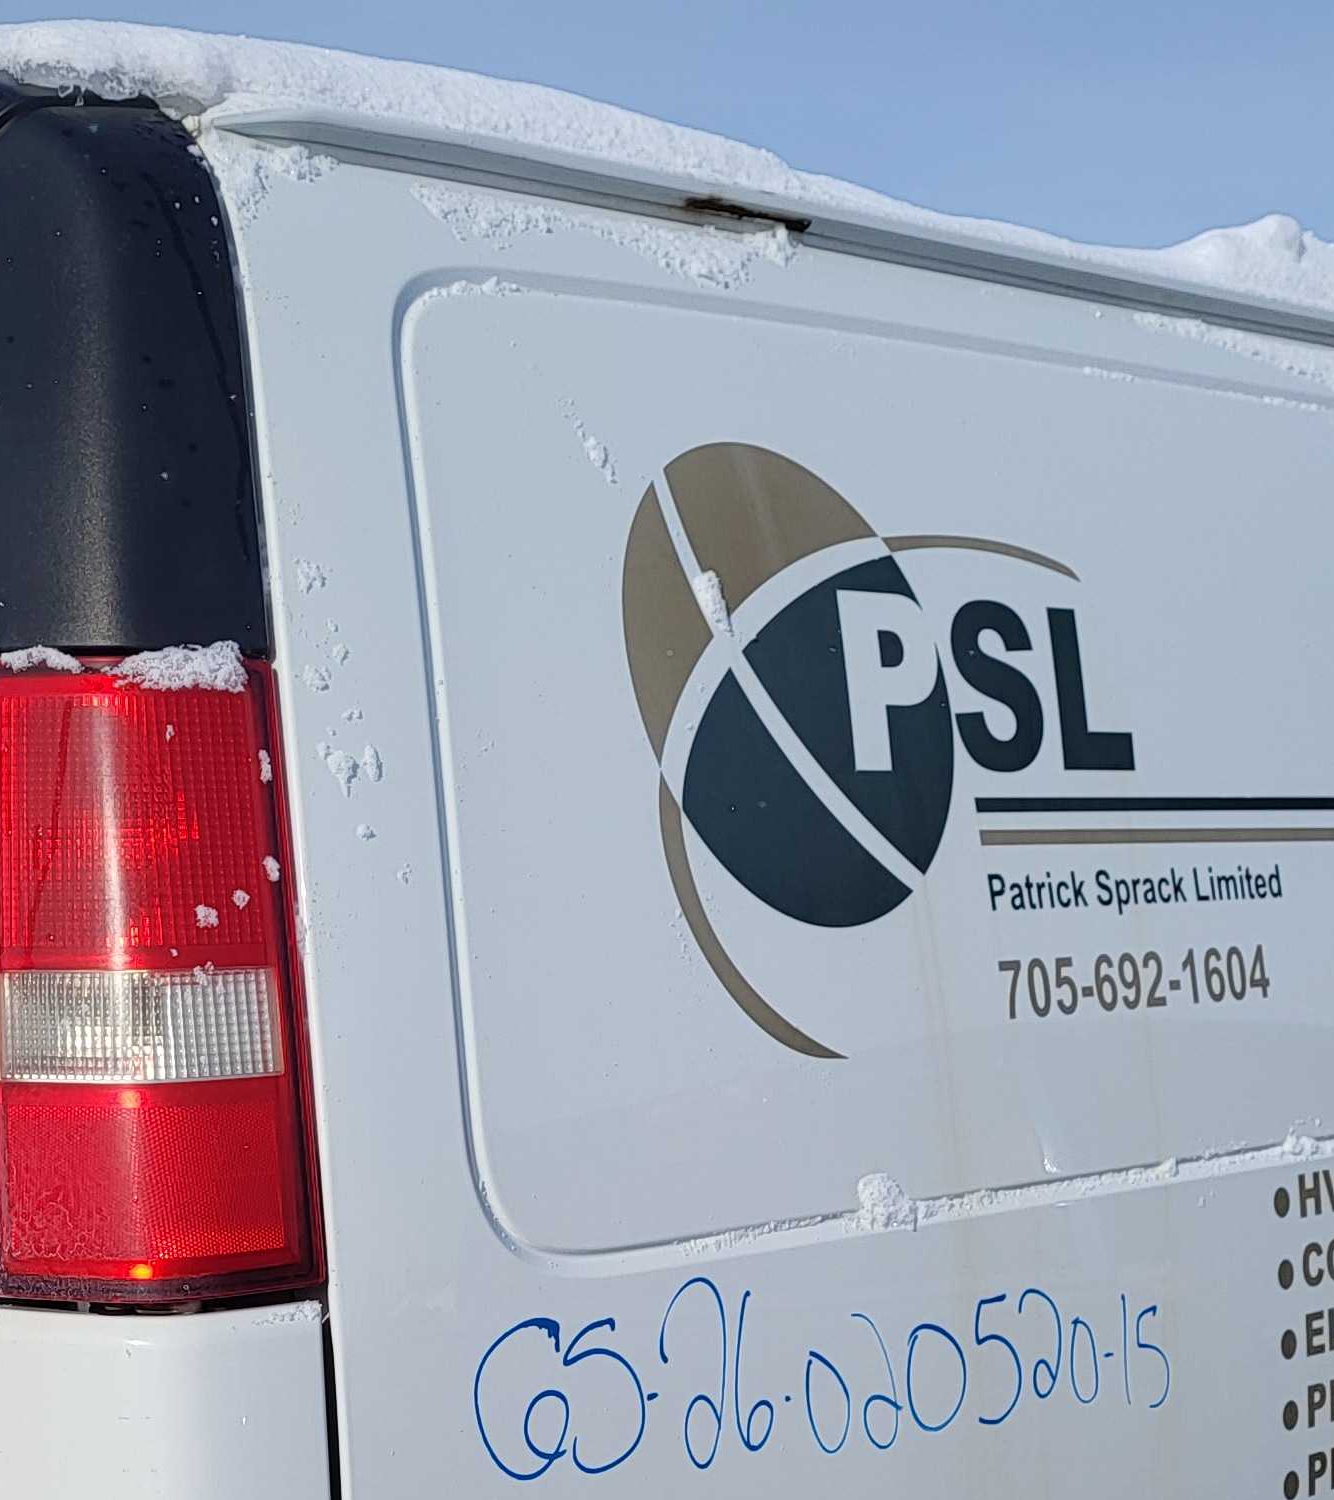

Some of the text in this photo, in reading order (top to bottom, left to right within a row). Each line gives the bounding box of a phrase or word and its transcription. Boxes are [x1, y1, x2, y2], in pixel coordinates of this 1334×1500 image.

[836, 590, 1135, 772] PSL
[987, 864, 1283, 914] Patrick Sprack Limited
[998, 944, 1270, 1019] 705-692-1604
